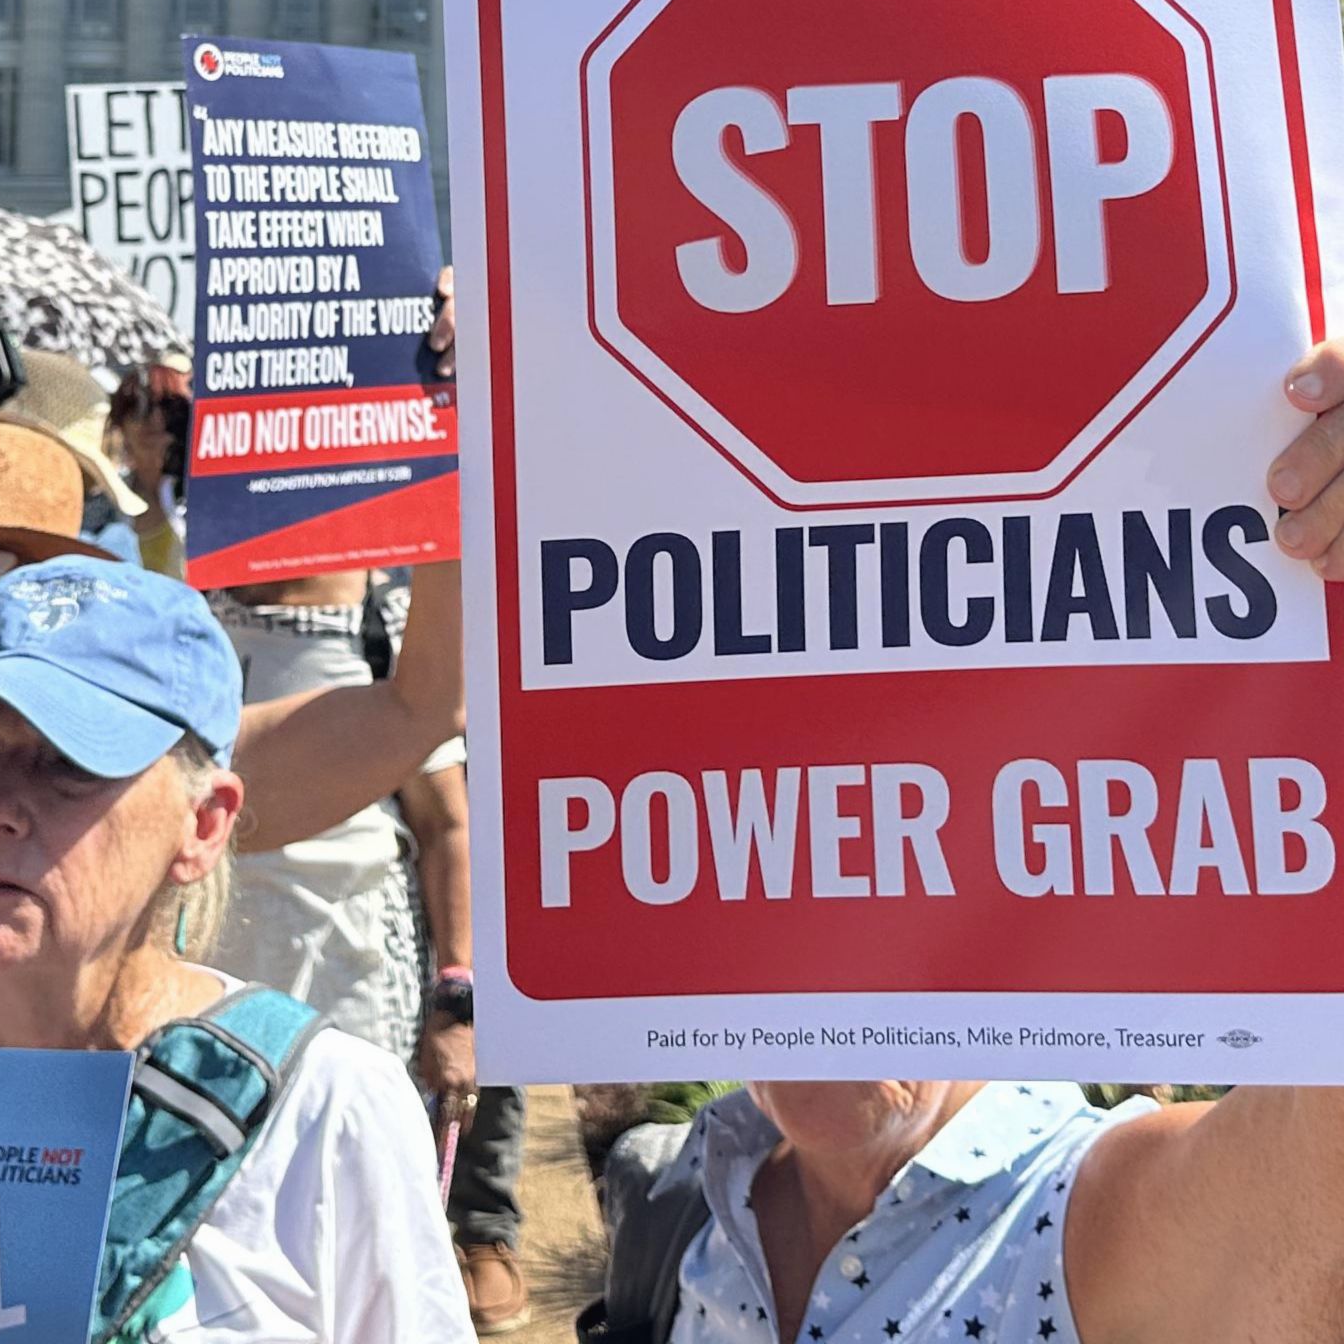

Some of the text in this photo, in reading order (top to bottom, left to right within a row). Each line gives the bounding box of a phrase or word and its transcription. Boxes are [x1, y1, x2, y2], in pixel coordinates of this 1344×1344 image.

[73, 89, 159, 160] LET
[246, 119, 338, 158] MEASURE
[337, 123, 421, 162] REFERRED
[203, 164, 399, 203] TO THE PEOPLE SHALL
[671, 72, 1181, 315] STOP
[205, 210, 384, 249] TAKE EFFECT WHEN
[208, 255, 314, 296] APPROVED
[316, 255, 343, 292] BY
[344, 254, 360, 292] A
[207, 296, 435, 343] MAJORITY OF THE VOTES
[206, 345, 354, 392] CAST THEREON,
[197, 411, 252, 459] AND
[255, 406, 303, 455] NOT
[540, 505, 1279, 665] POLITICIANS
[538, 757, 1336, 909] POWER GRAB
[647, 1029, 686, 1047] Paid
[693, 1029, 718, 1047] for
[724, 1028, 745, 1050] by
[752, 1027, 814, 1049] People
[821, 1028, 855, 1045] Not
[862, 1027, 960, 1048] Politicians,
[967, 1027, 1012, 1046] Mike
[1020, 1027, 1110, 1049] Pridmore,
[1115, 1028, 1204, 1047] Treasurer
[41, 1147, 85, 1166] NOT
